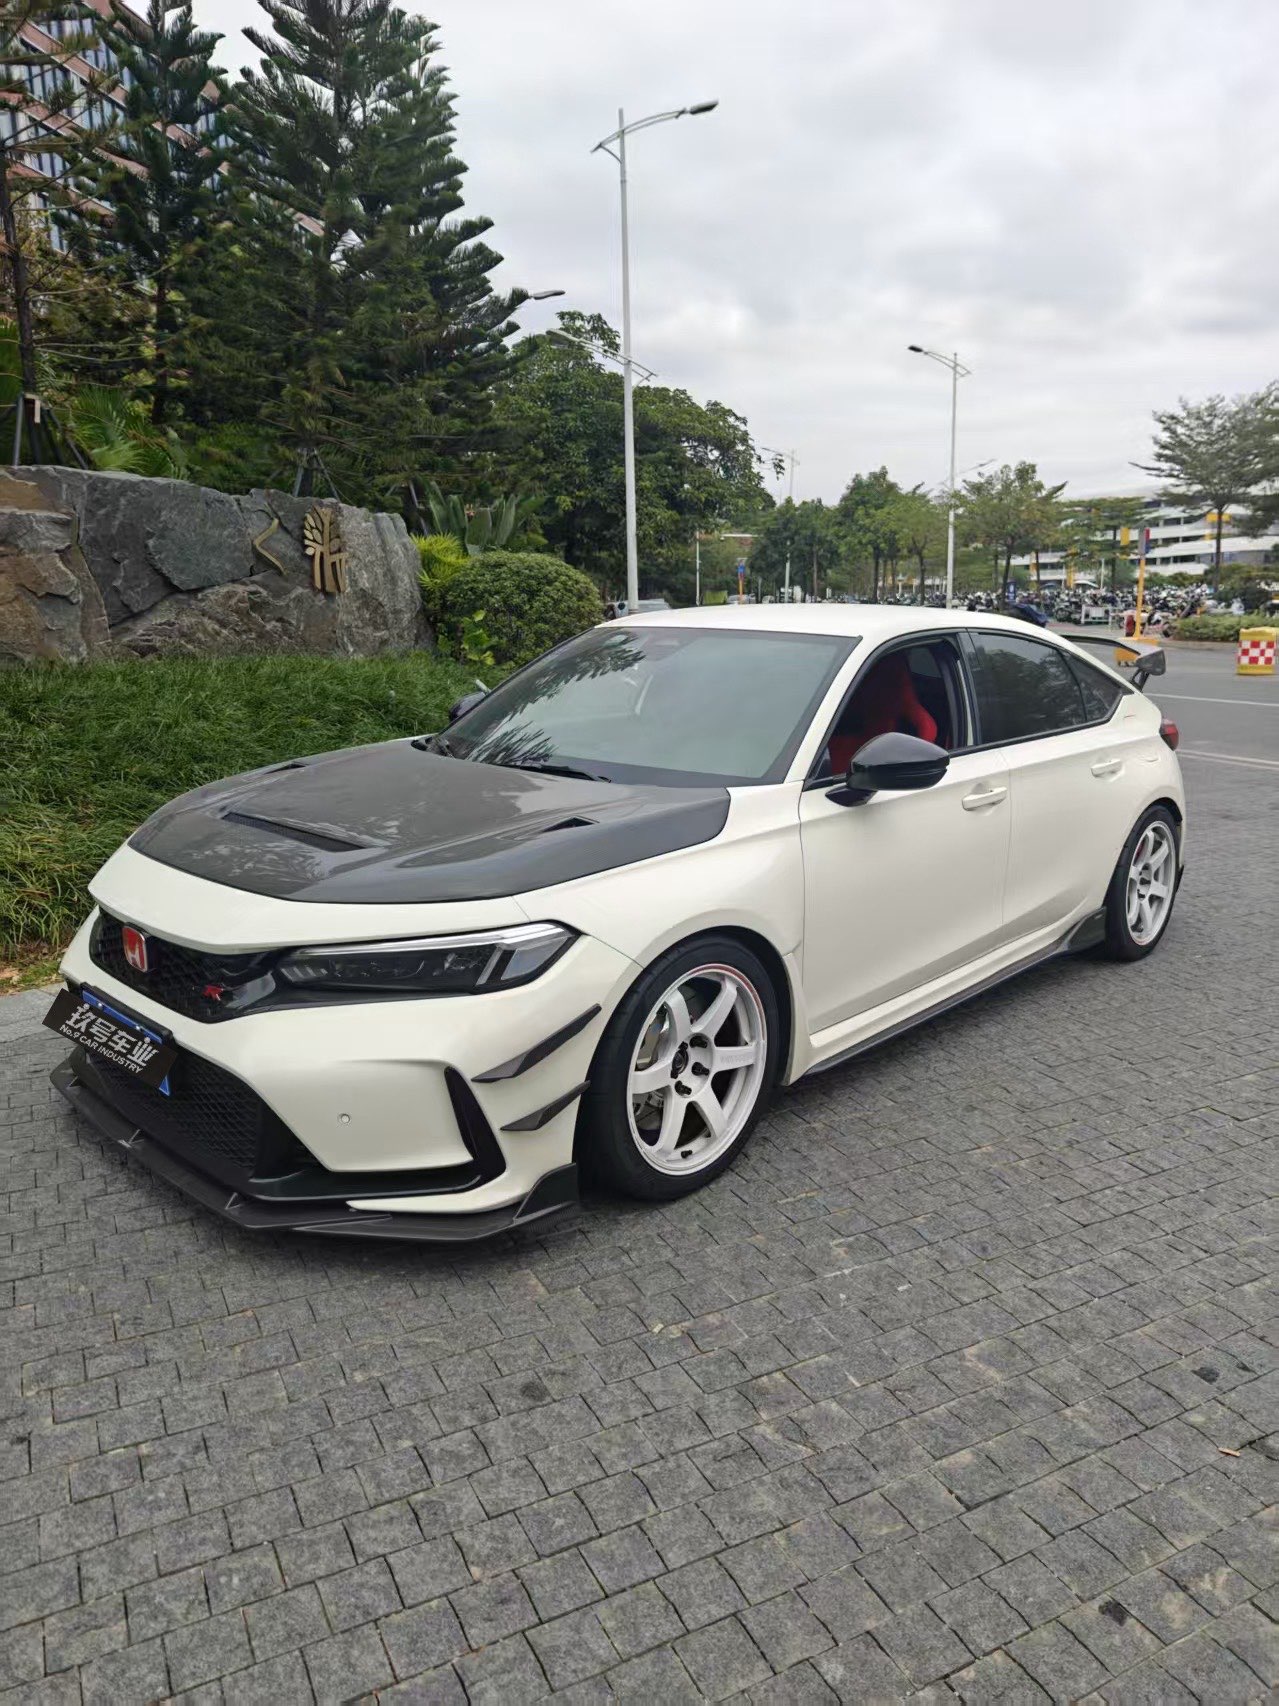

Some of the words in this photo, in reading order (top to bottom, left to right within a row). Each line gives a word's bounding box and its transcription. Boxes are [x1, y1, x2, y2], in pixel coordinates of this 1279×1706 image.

[59, 1024, 81, 1039] No.9
[79, 1034, 99, 1050] CAR
[98, 1044, 143, 1074] INDUSTRY
[65, 1004, 159, 1067] 玖号车业
